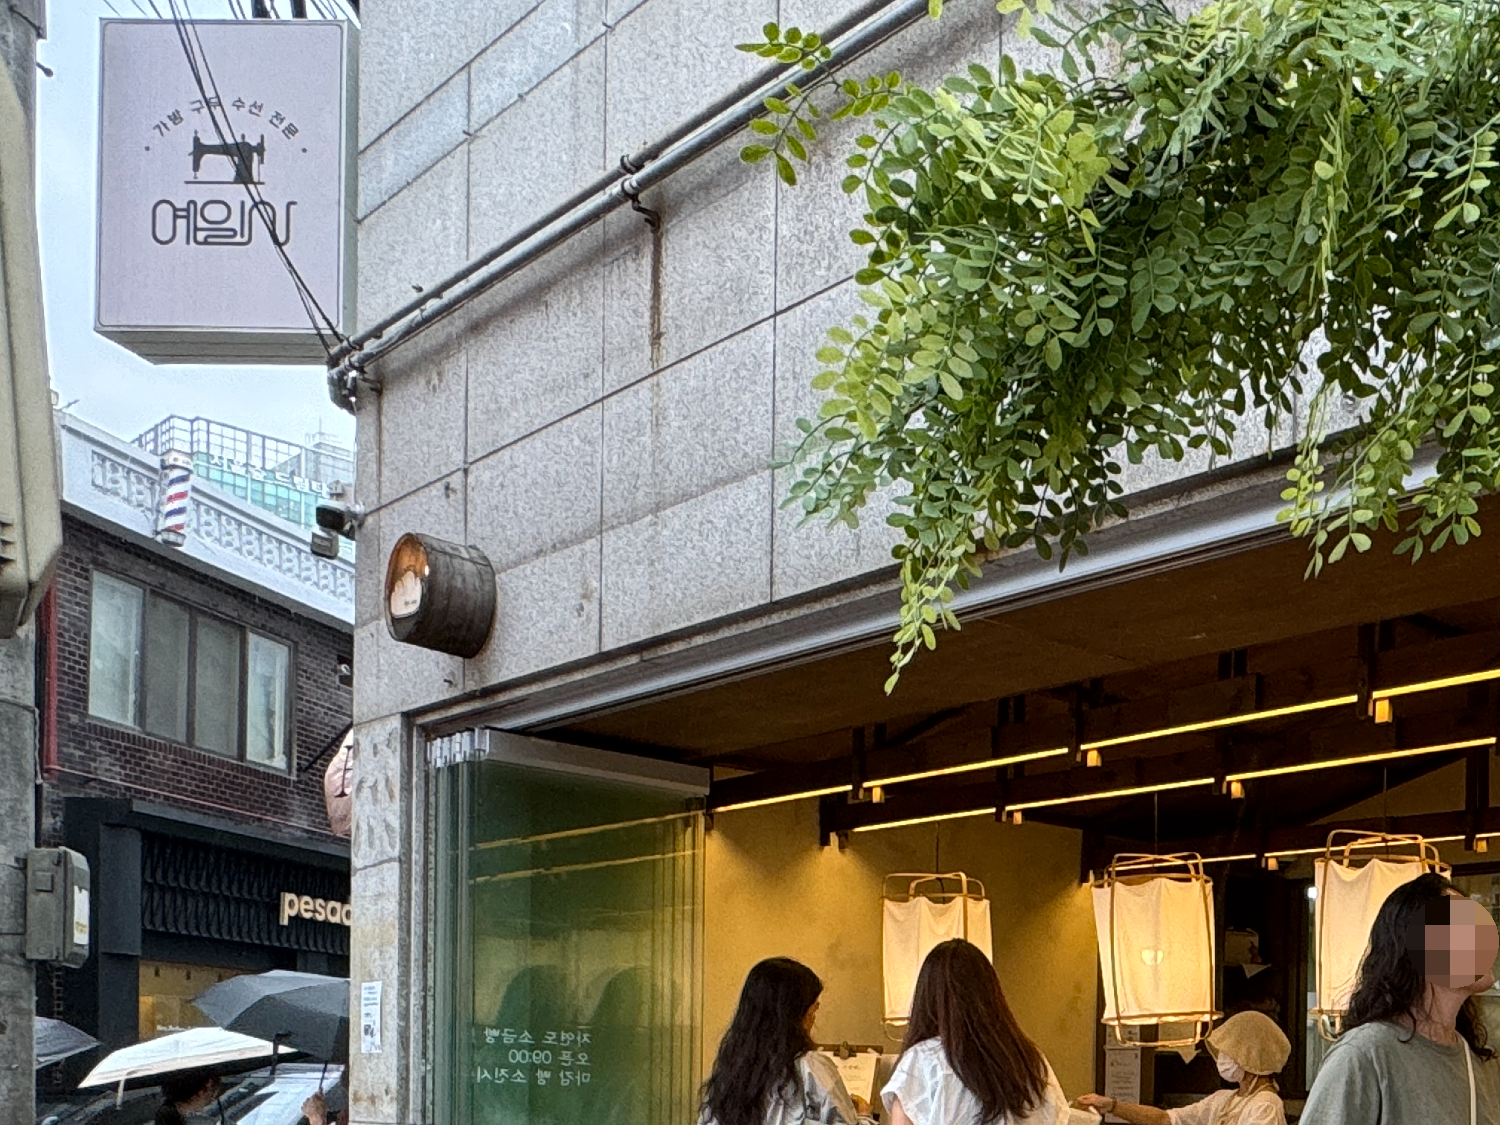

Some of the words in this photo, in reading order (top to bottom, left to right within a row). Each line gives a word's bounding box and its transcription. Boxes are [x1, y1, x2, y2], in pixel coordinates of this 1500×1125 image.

[152, 108, 184, 137] 가방
[232, 97, 264, 117] 수선
[269, 110, 299, 140] 전문
[273, 471, 330, 499] 드림타
